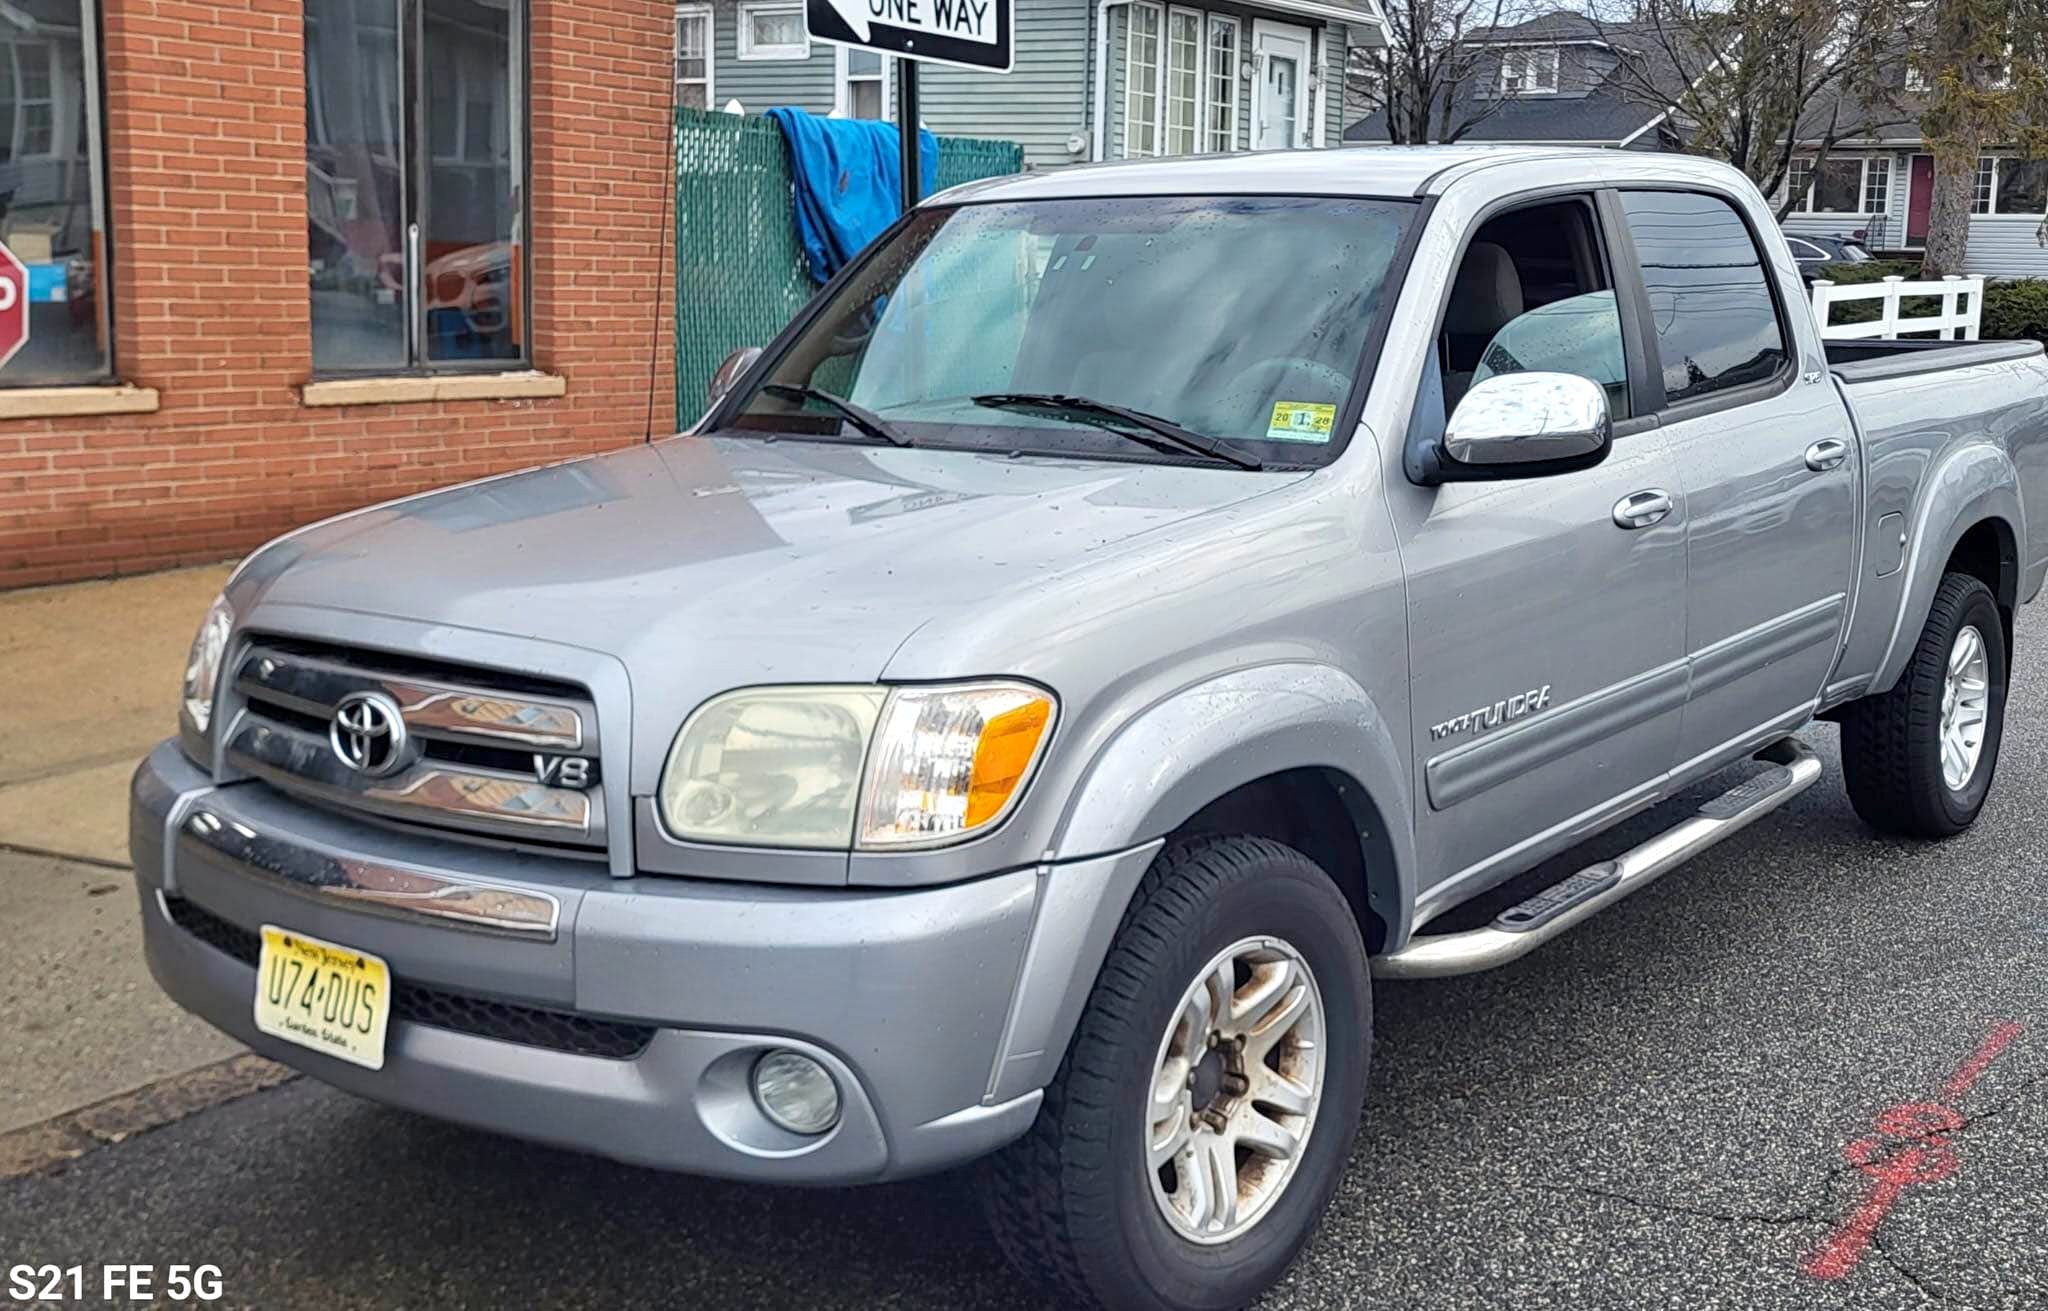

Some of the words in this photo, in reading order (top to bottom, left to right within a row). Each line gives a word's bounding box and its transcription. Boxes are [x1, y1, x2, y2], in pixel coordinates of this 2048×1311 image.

[934, 0, 988, 36] WAY
[1471, 685, 1550, 734] TUNDRA
[533, 754, 589, 788] V8
